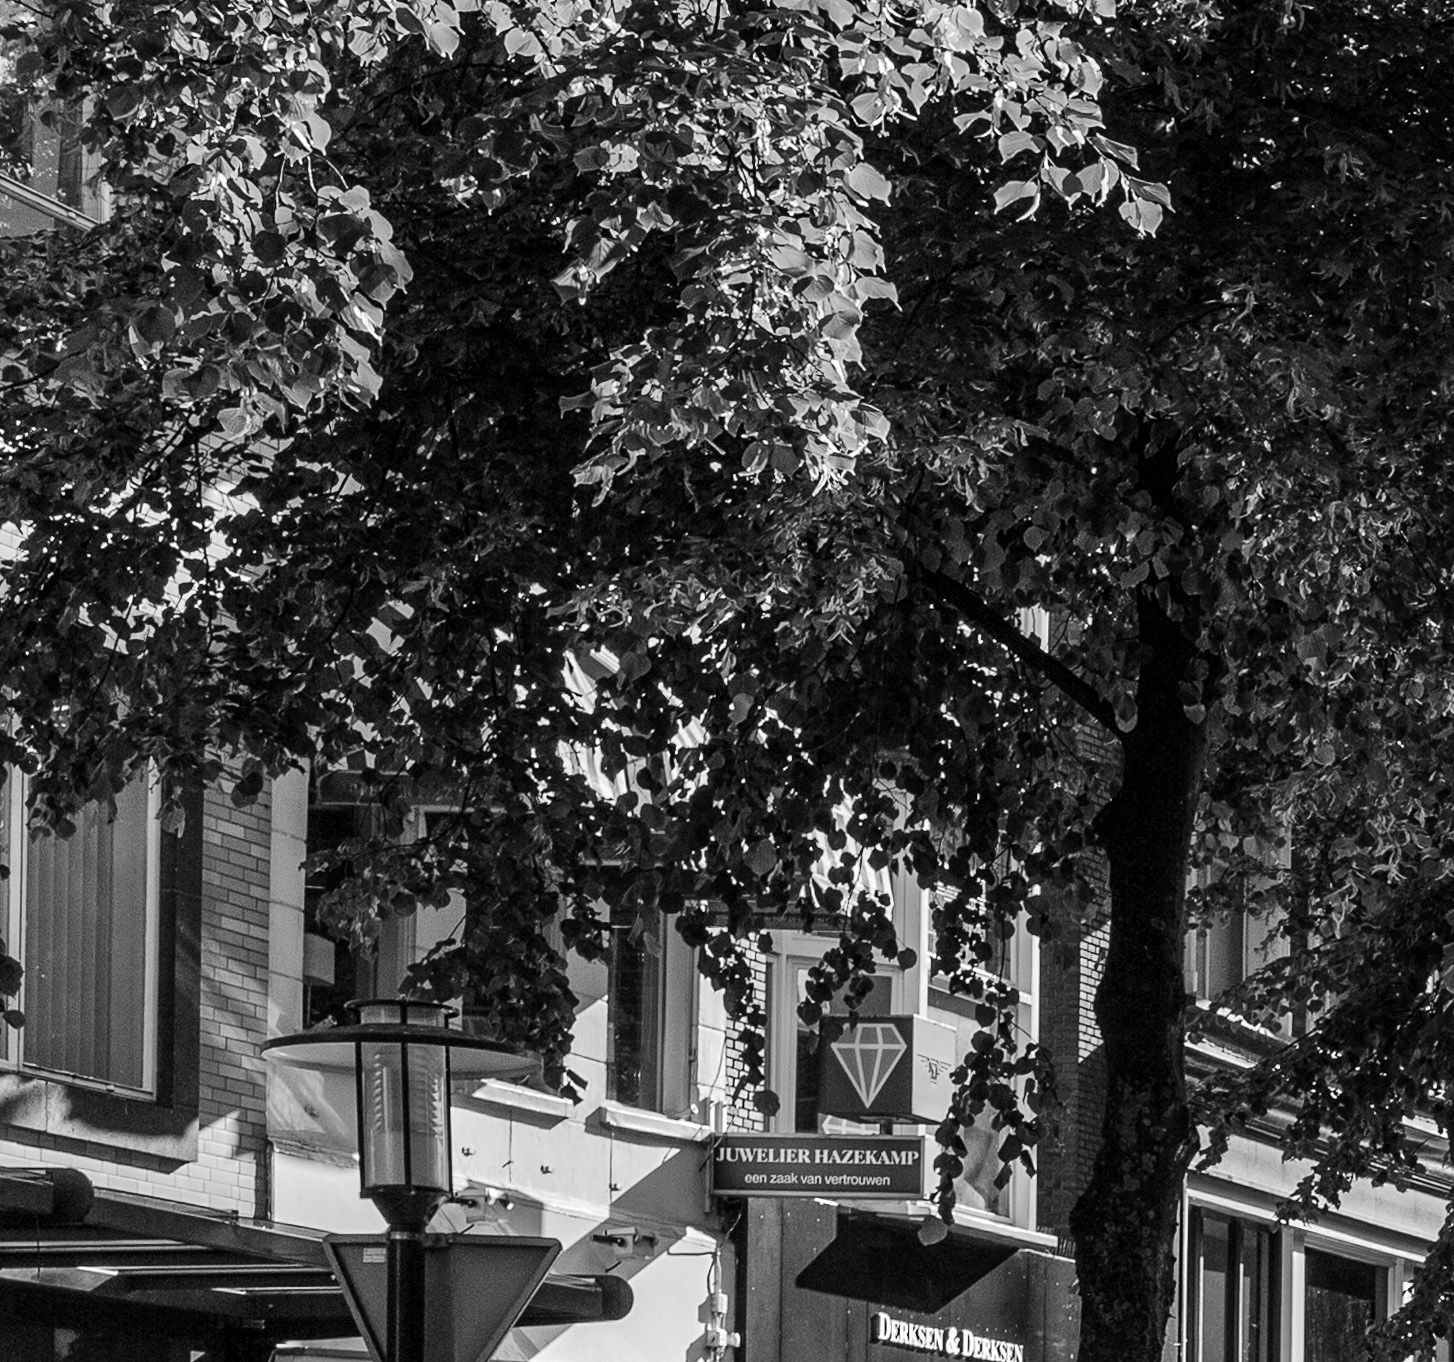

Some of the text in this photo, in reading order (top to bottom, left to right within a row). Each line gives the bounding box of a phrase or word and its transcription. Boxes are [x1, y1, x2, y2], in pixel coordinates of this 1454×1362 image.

[716, 1147, 919, 1165] JUWELIER HAZEKAMP
[744, 1173, 890, 1186] een zaak van vertrouwen
[878, 1312, 945, 1351] DERKSEN
[945, 1326, 961, 1355] &
